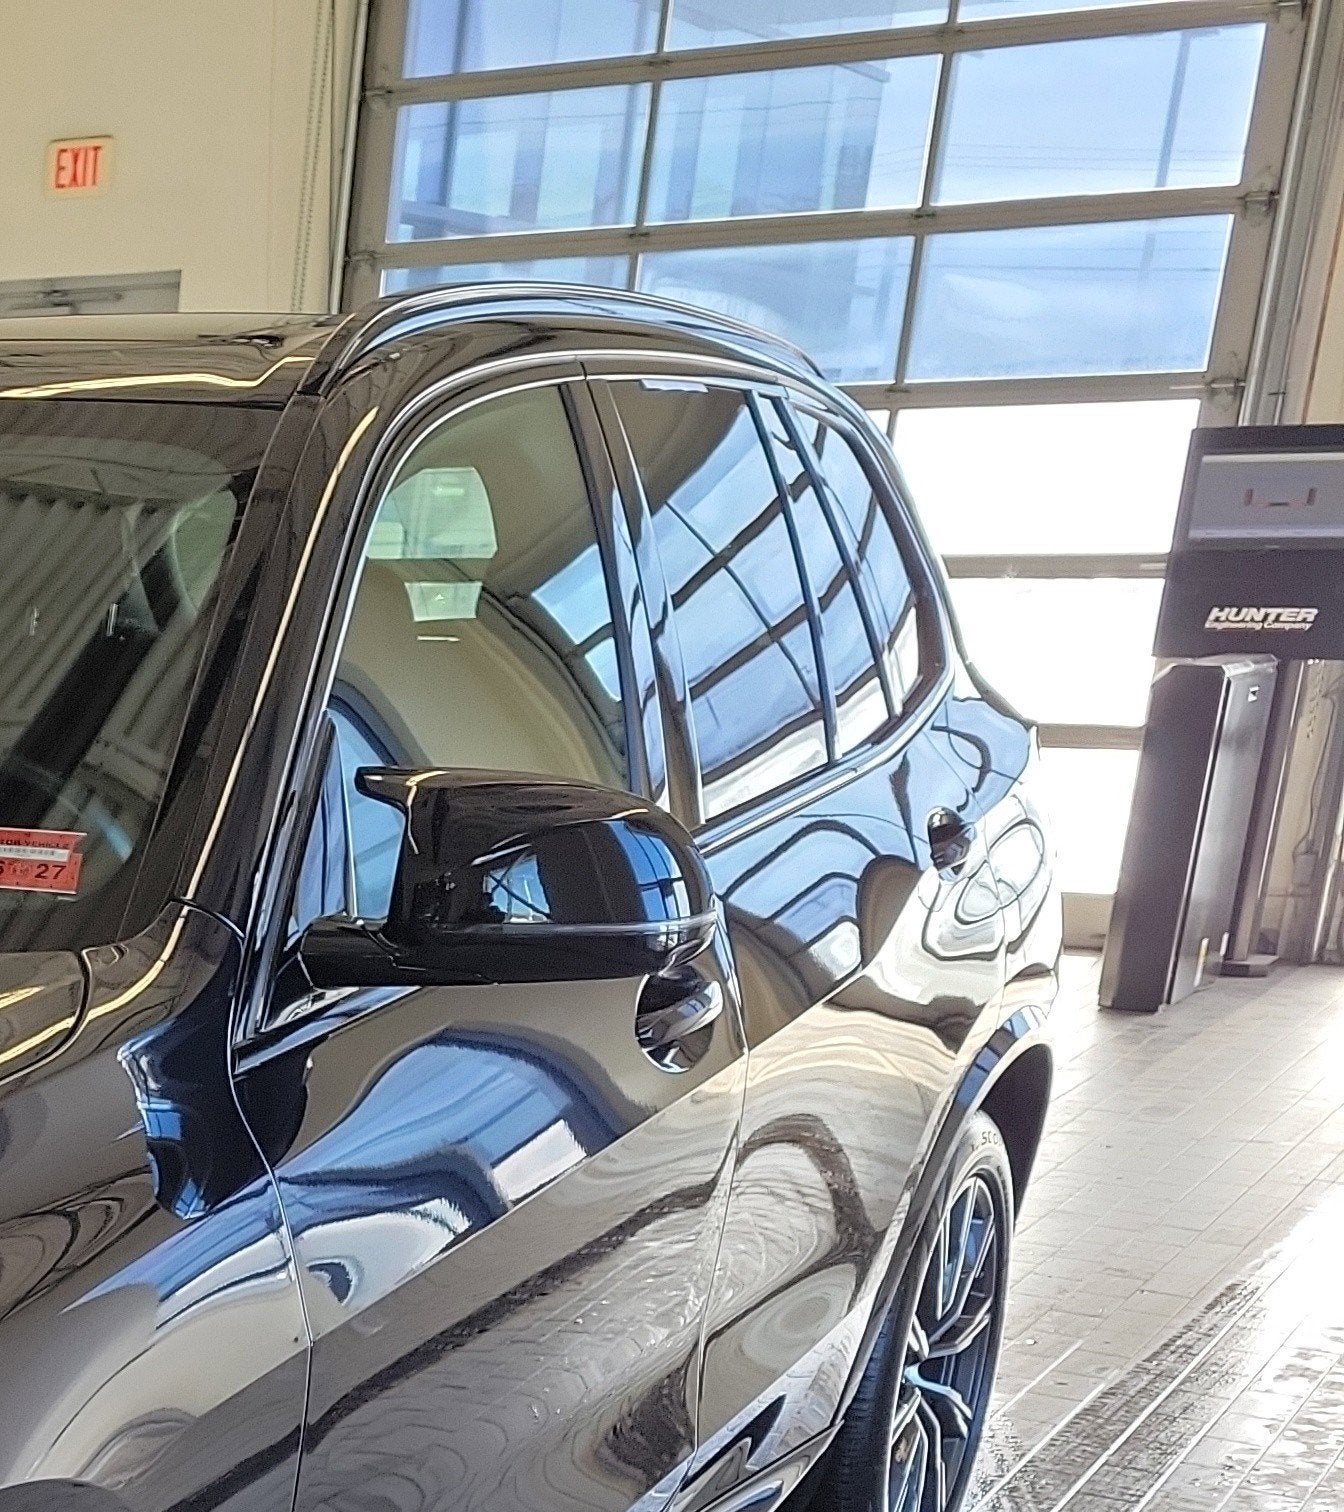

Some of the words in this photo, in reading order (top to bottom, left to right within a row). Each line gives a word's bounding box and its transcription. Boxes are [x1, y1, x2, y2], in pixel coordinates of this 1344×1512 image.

[55, 146, 102, 188] EXIT
[1206, 607, 1319, 622] HUNTER
[34, 863, 67, 880] 27
